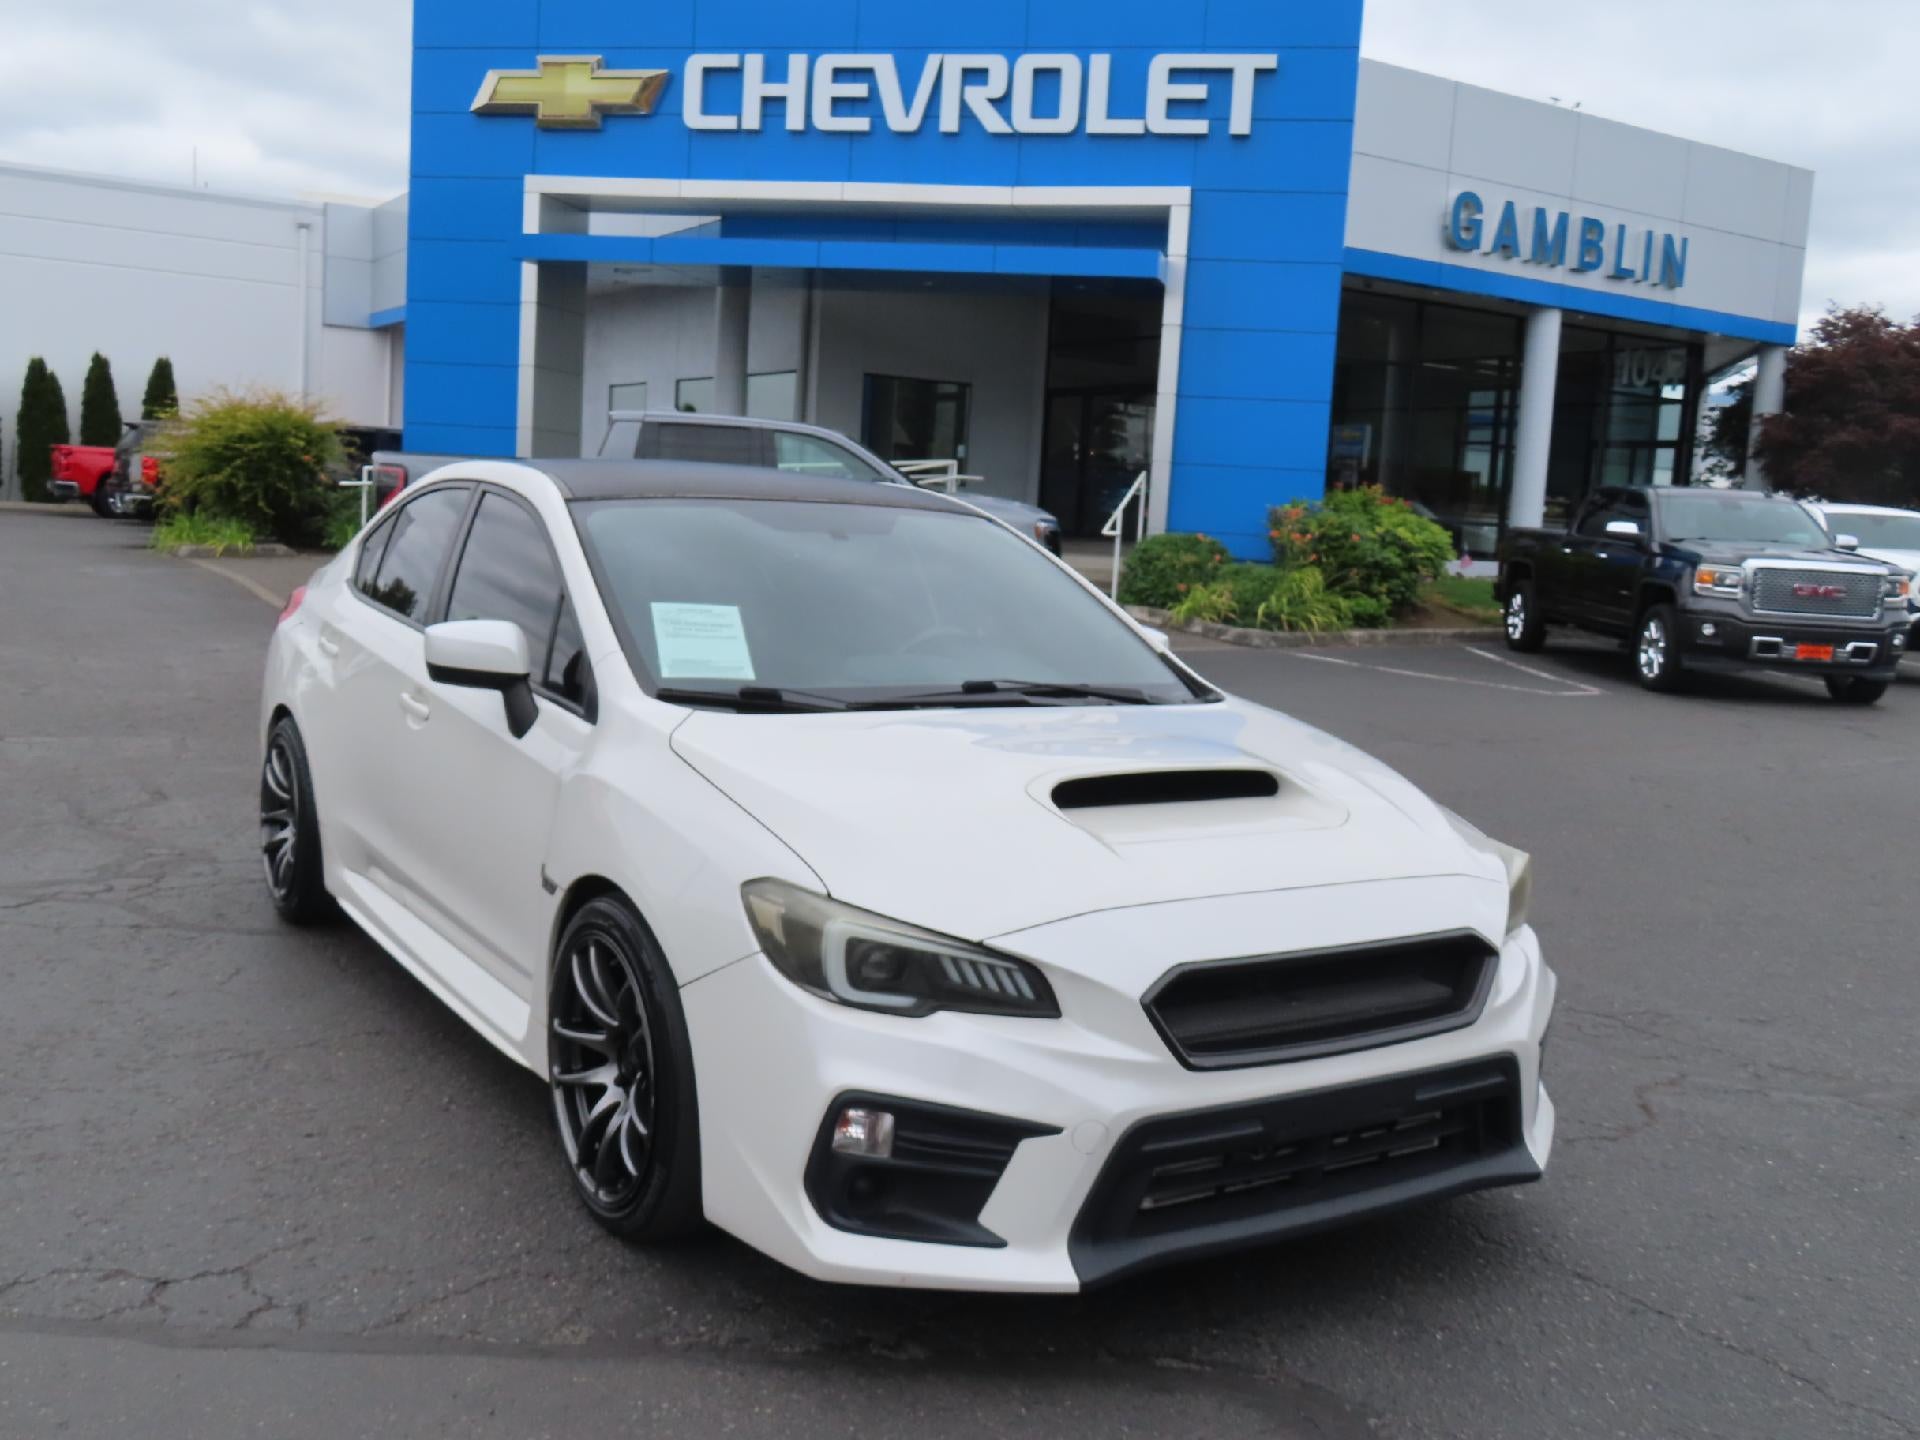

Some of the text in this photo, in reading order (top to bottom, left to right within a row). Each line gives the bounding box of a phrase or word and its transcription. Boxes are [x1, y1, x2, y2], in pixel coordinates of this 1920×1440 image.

[683, 53, 1278, 136] CHEVROLET
[1447, 190, 1689, 288] GAMBLIN
[1793, 583, 1849, 598] GMC
